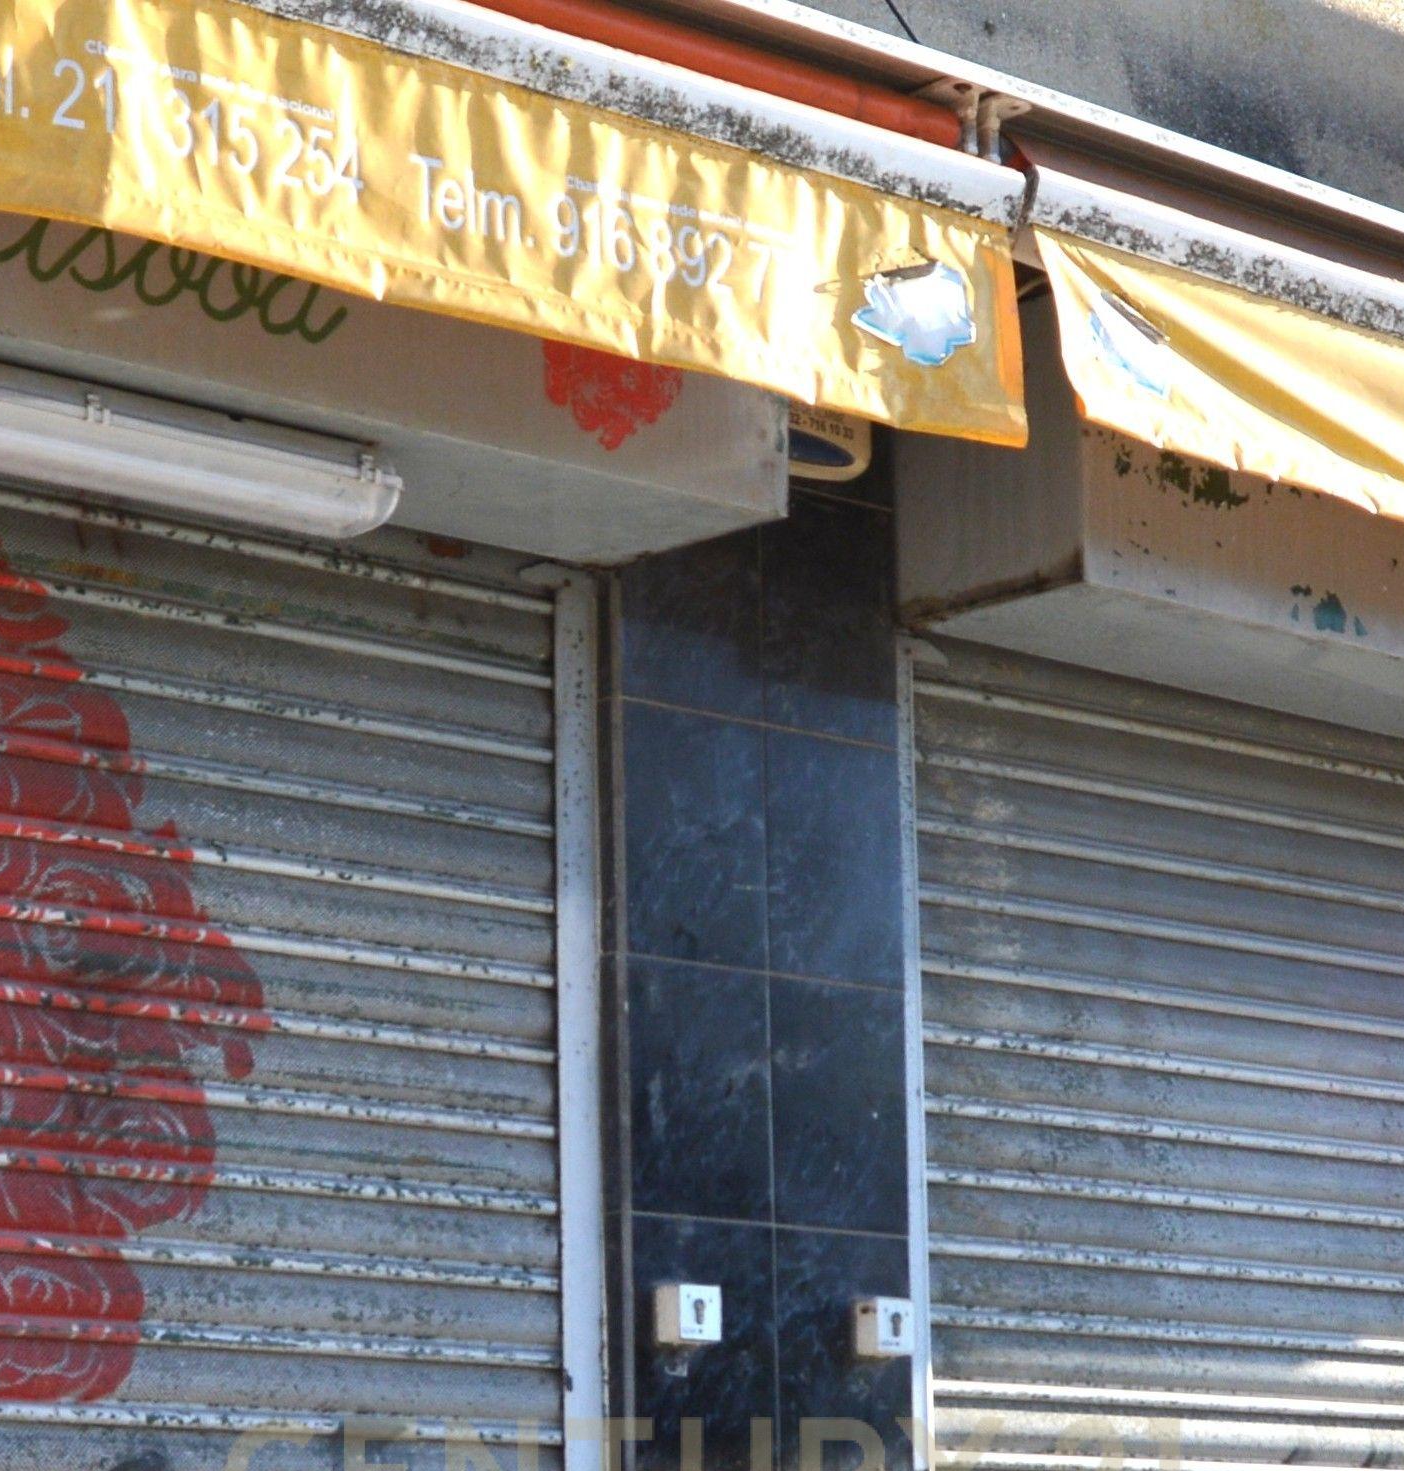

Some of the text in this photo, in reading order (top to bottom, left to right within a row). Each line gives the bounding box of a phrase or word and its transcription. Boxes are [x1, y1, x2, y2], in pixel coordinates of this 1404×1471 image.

[163, 88, 260, 175] 315
[274, 116, 364, 198] 254
[409, 153, 535, 248] Telm.
